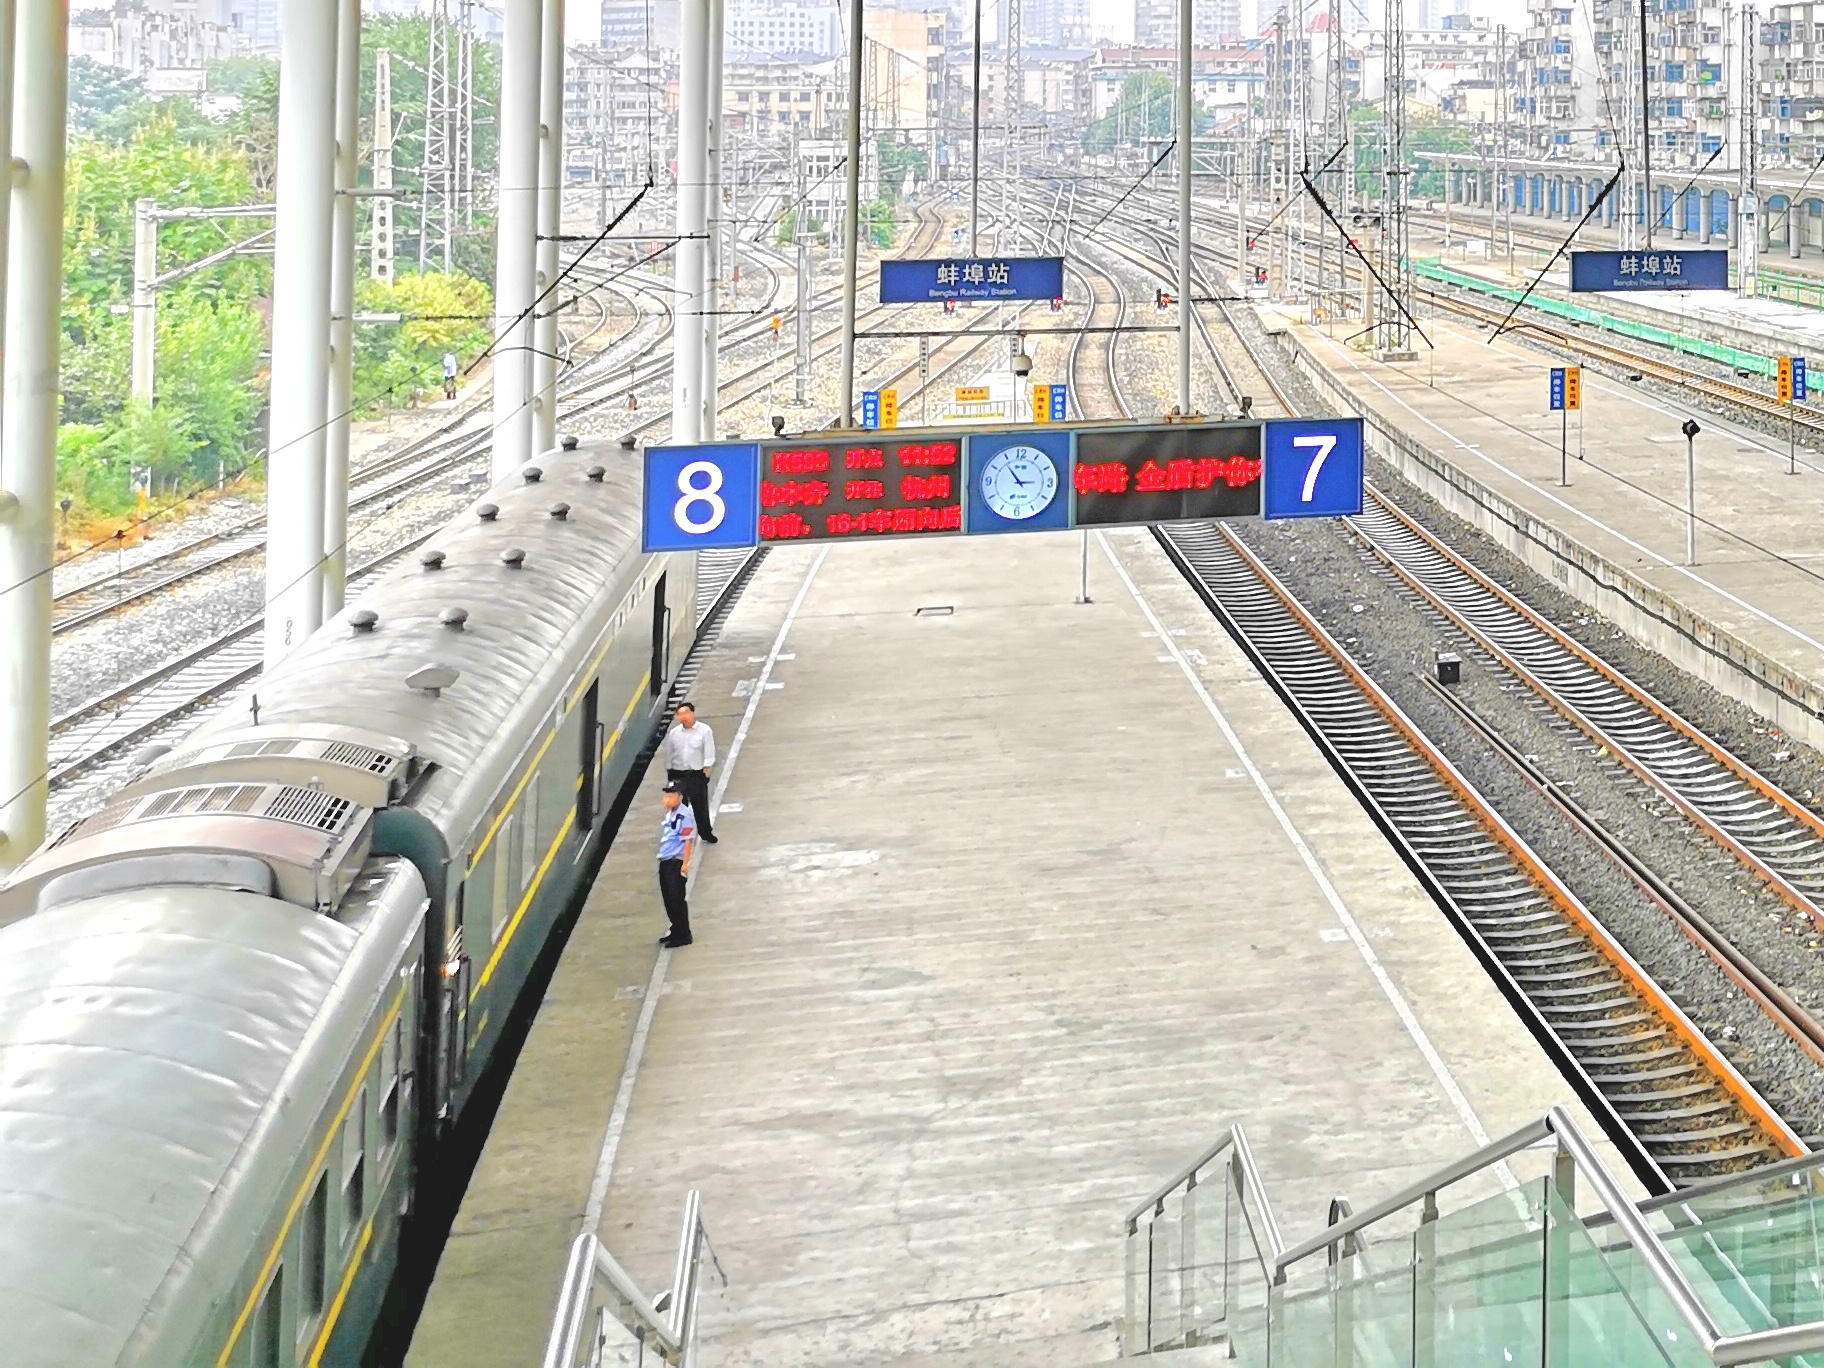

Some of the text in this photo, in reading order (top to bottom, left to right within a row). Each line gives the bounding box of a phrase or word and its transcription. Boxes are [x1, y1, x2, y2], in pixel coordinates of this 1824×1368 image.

[936, 262, 1010, 285] 蚌埠站
[1619, 255, 1682, 277] 蚌埠站
[1292, 435, 1338, 503] 7
[673, 461, 726, 534] 8
